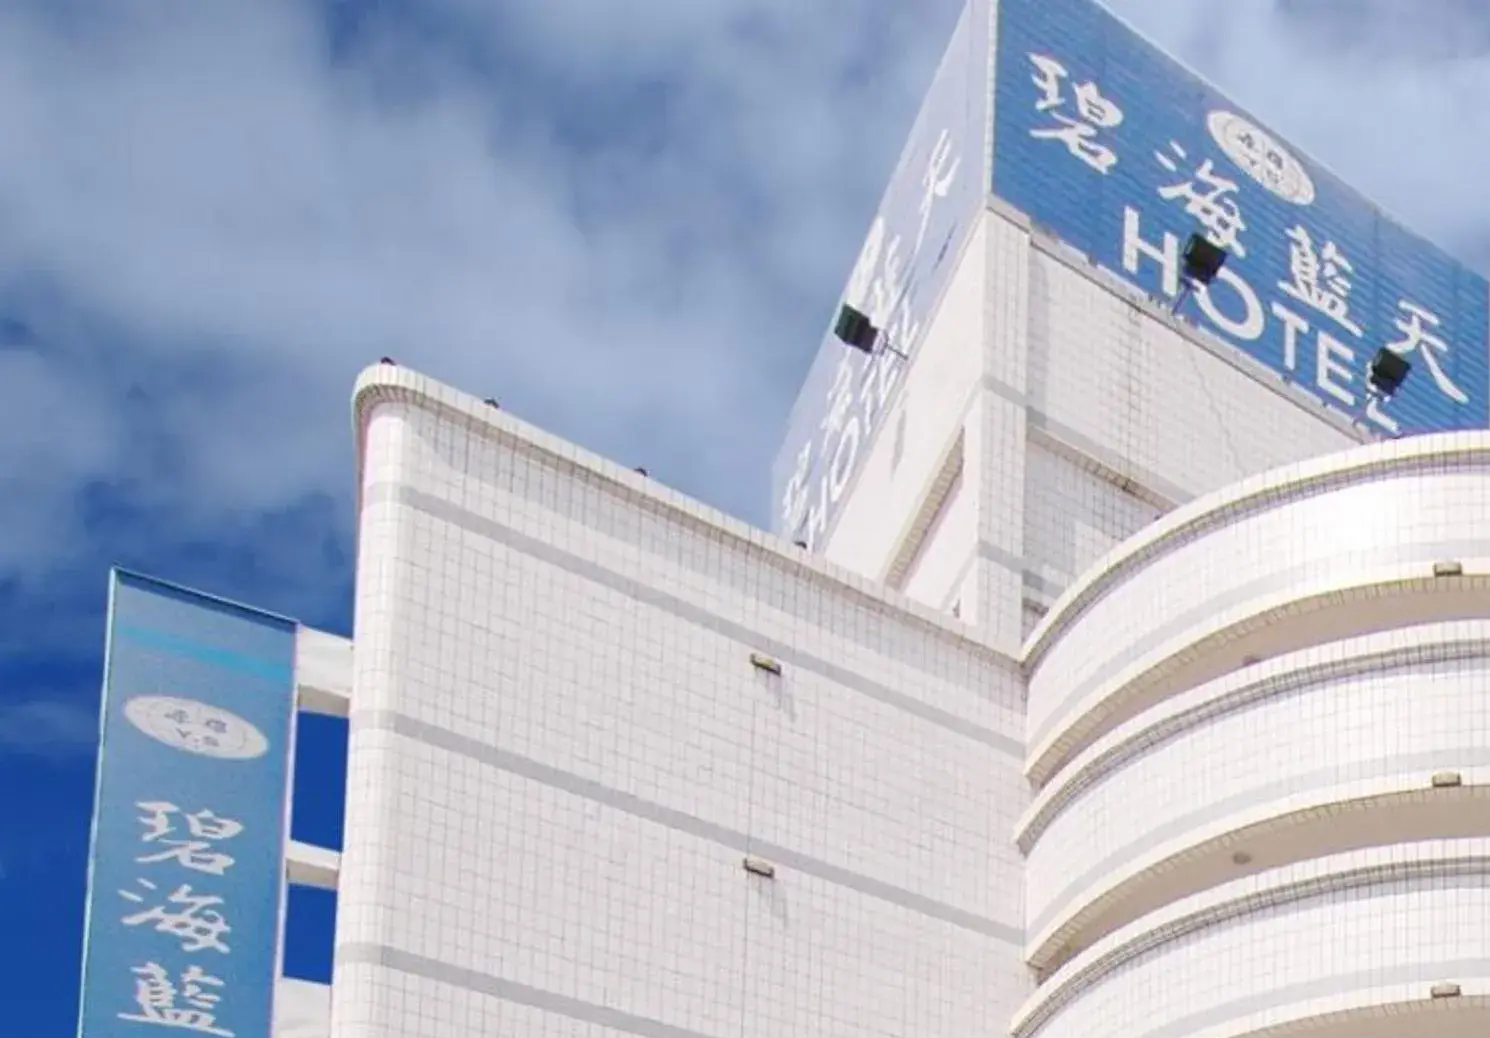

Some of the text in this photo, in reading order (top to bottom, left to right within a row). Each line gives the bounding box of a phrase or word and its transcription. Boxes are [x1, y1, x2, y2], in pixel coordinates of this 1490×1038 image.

[1028, 52, 1469, 404] 碧海藍天
[1121, 205, 1399, 434] HOTEL
